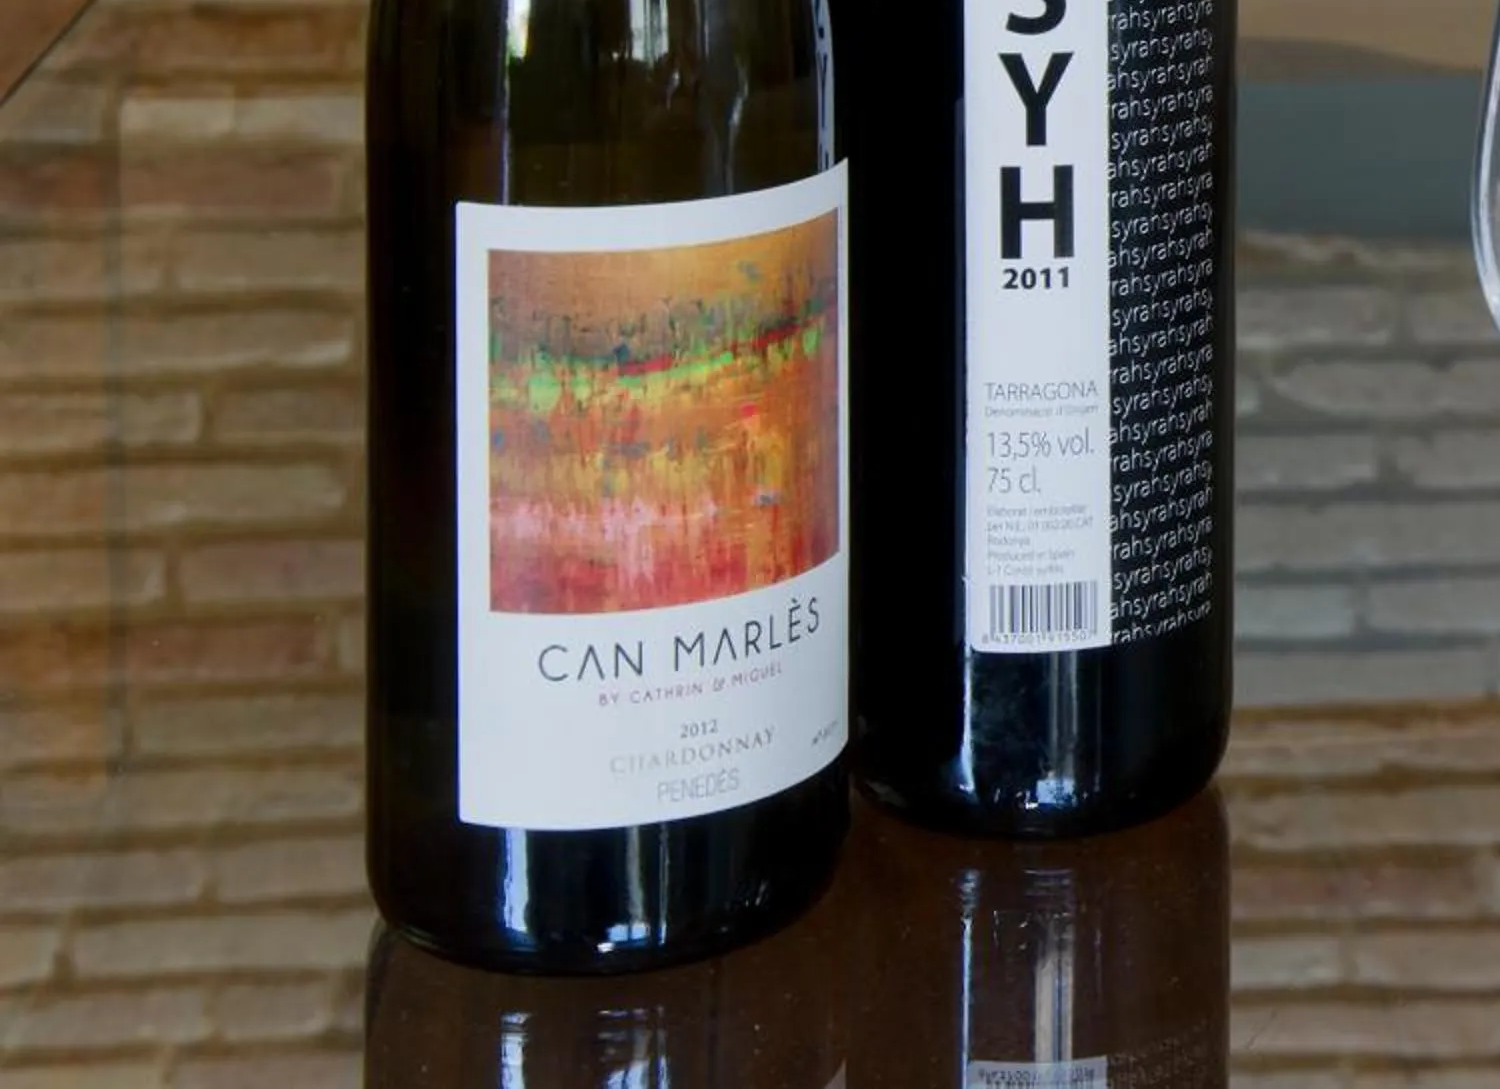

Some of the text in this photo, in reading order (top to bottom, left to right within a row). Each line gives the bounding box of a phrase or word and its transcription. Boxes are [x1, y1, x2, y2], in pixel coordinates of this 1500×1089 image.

[1002, 266, 1070, 290] 2011
[984, 380, 1098, 401] TARRAGONA
[986, 427, 1095, 460] 13,5% vol.
[986, 465, 1041, 493] 75 cl.
[538, 597, 820, 682] CAN MARLÈS
[599, 692, 620, 707] BY
[630, 682, 703, 705] CATHRIN
[731, 661, 783, 688] MIGUEL
[680, 719, 719, 740] 2012
[609, 726, 776, 775] CHARDONNAY
